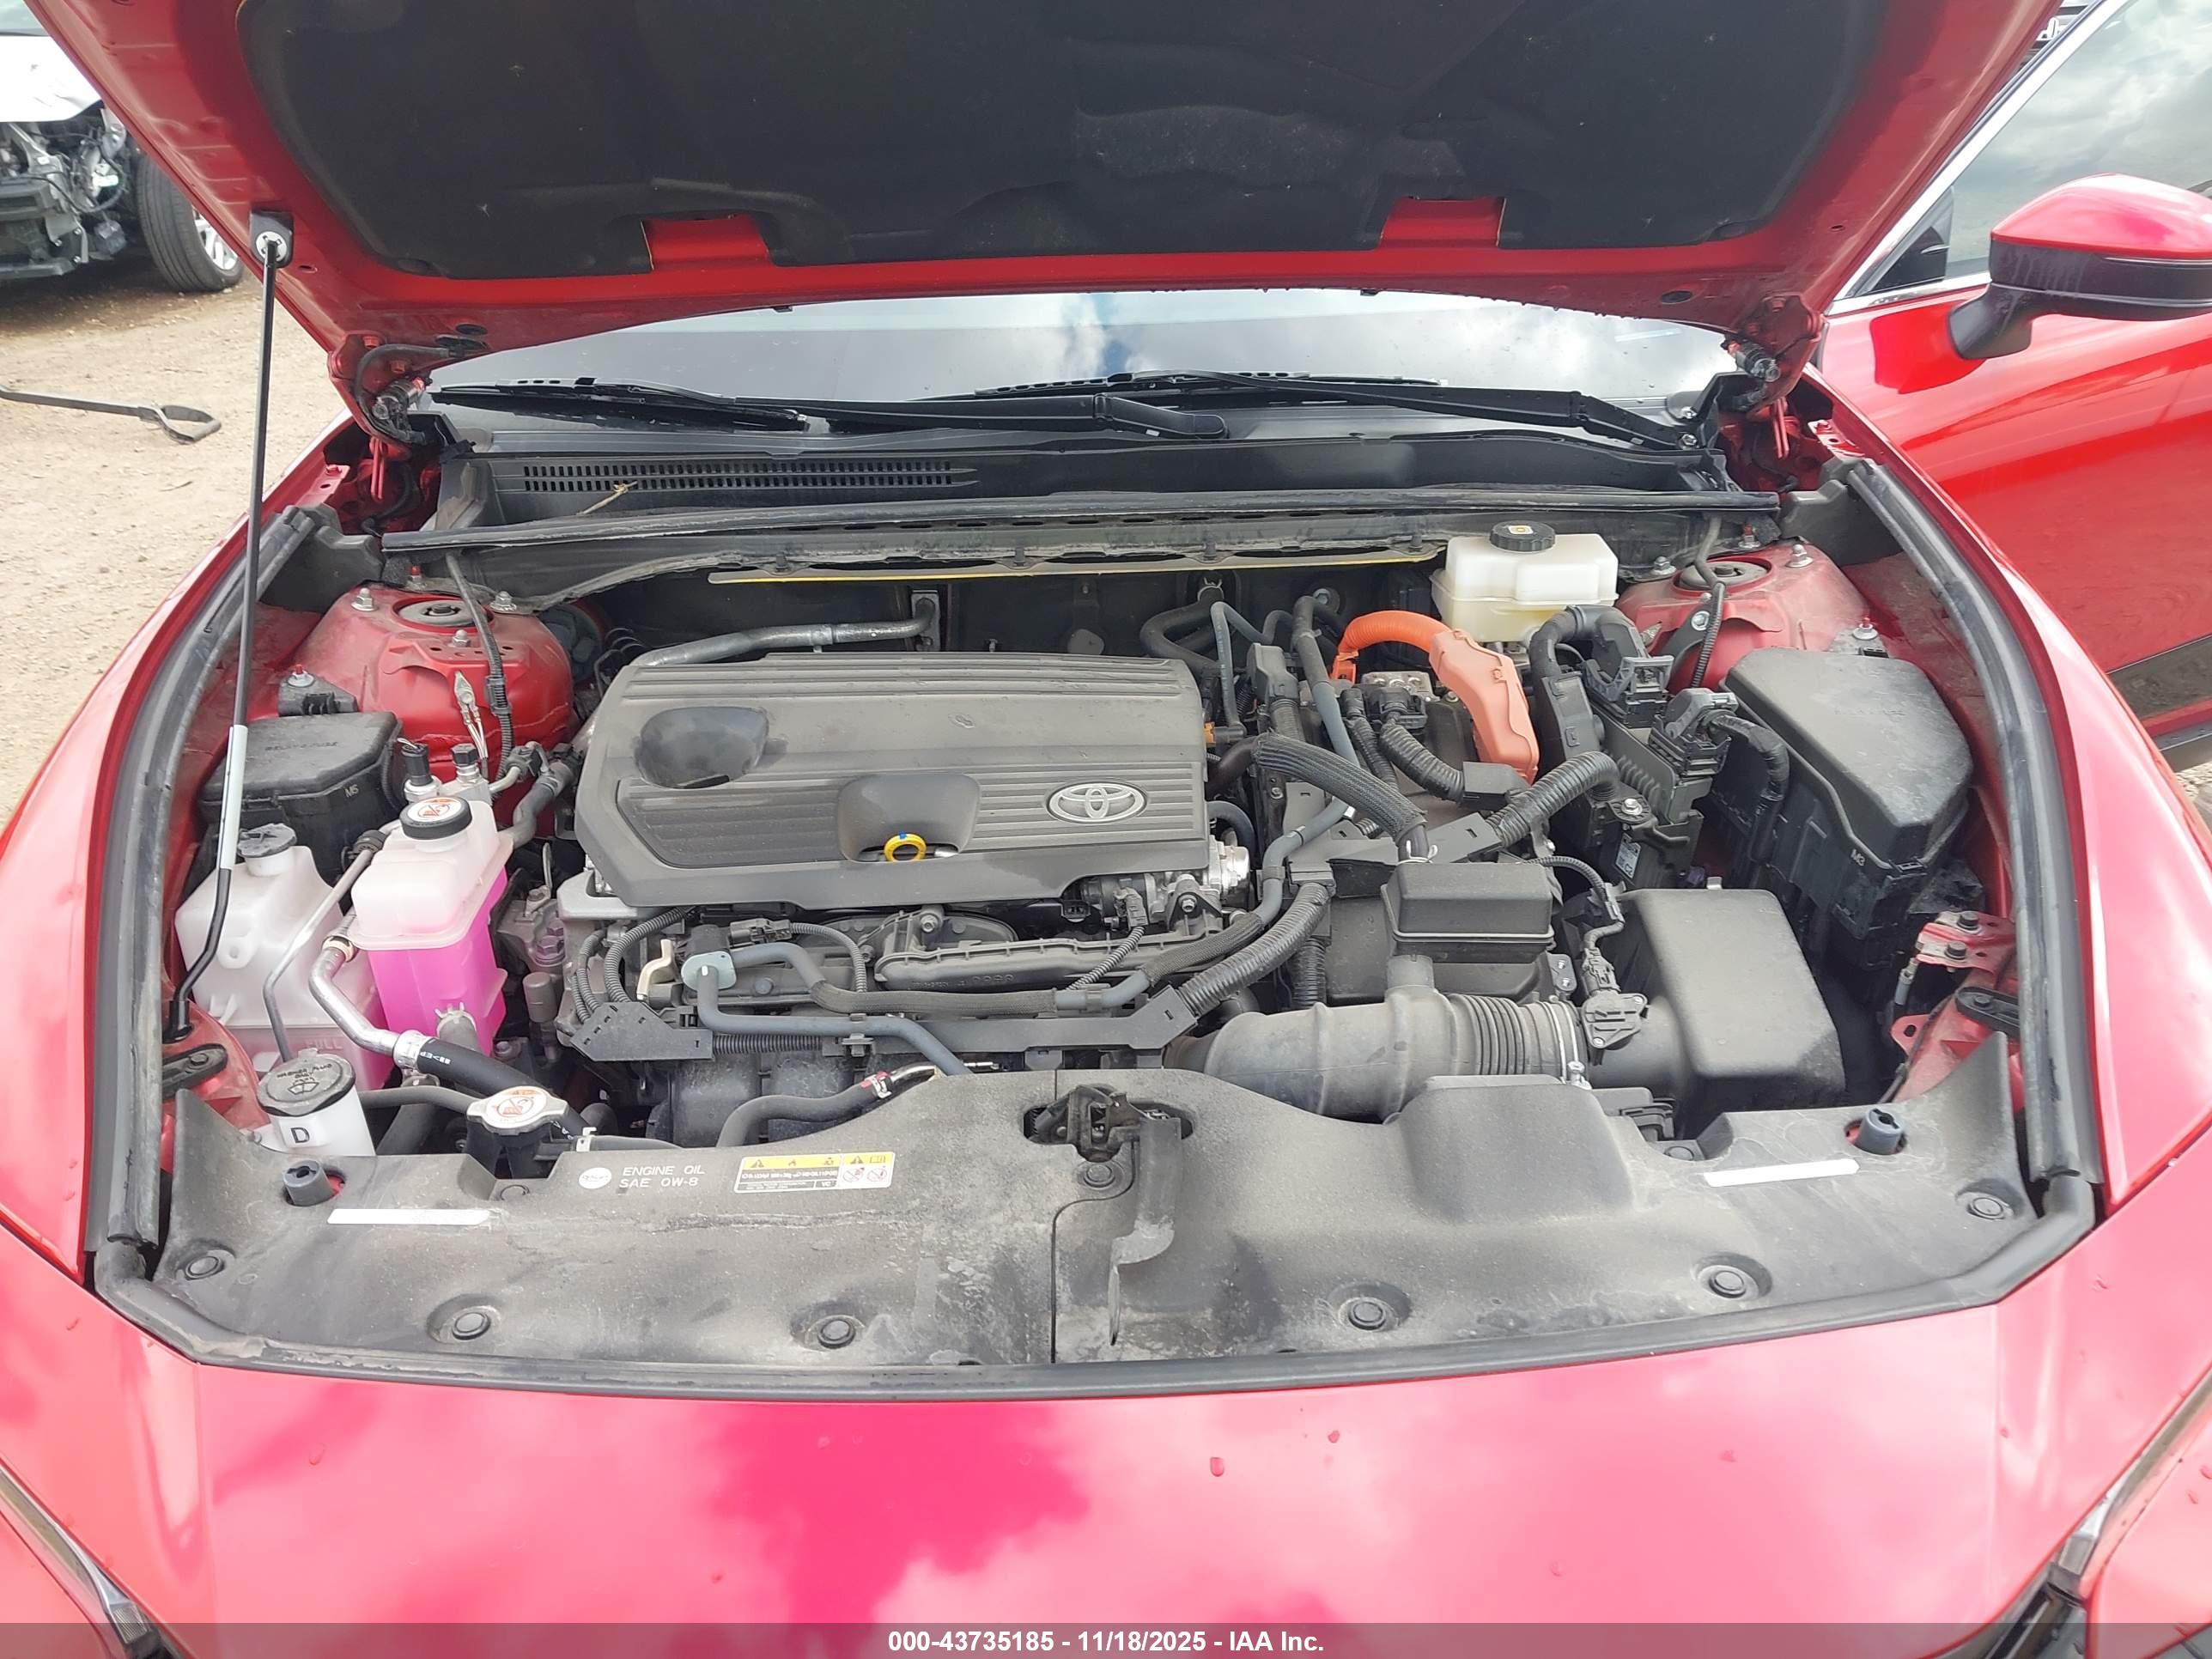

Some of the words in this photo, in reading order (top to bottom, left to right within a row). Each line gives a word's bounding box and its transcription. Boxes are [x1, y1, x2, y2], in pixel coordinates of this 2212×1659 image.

[290, 1127, 310, 1144] D
[622, 1165, 675, 1176] ENGINE
[684, 1164, 706, 1176] OIL
[618, 1177, 652, 1188] SAE
